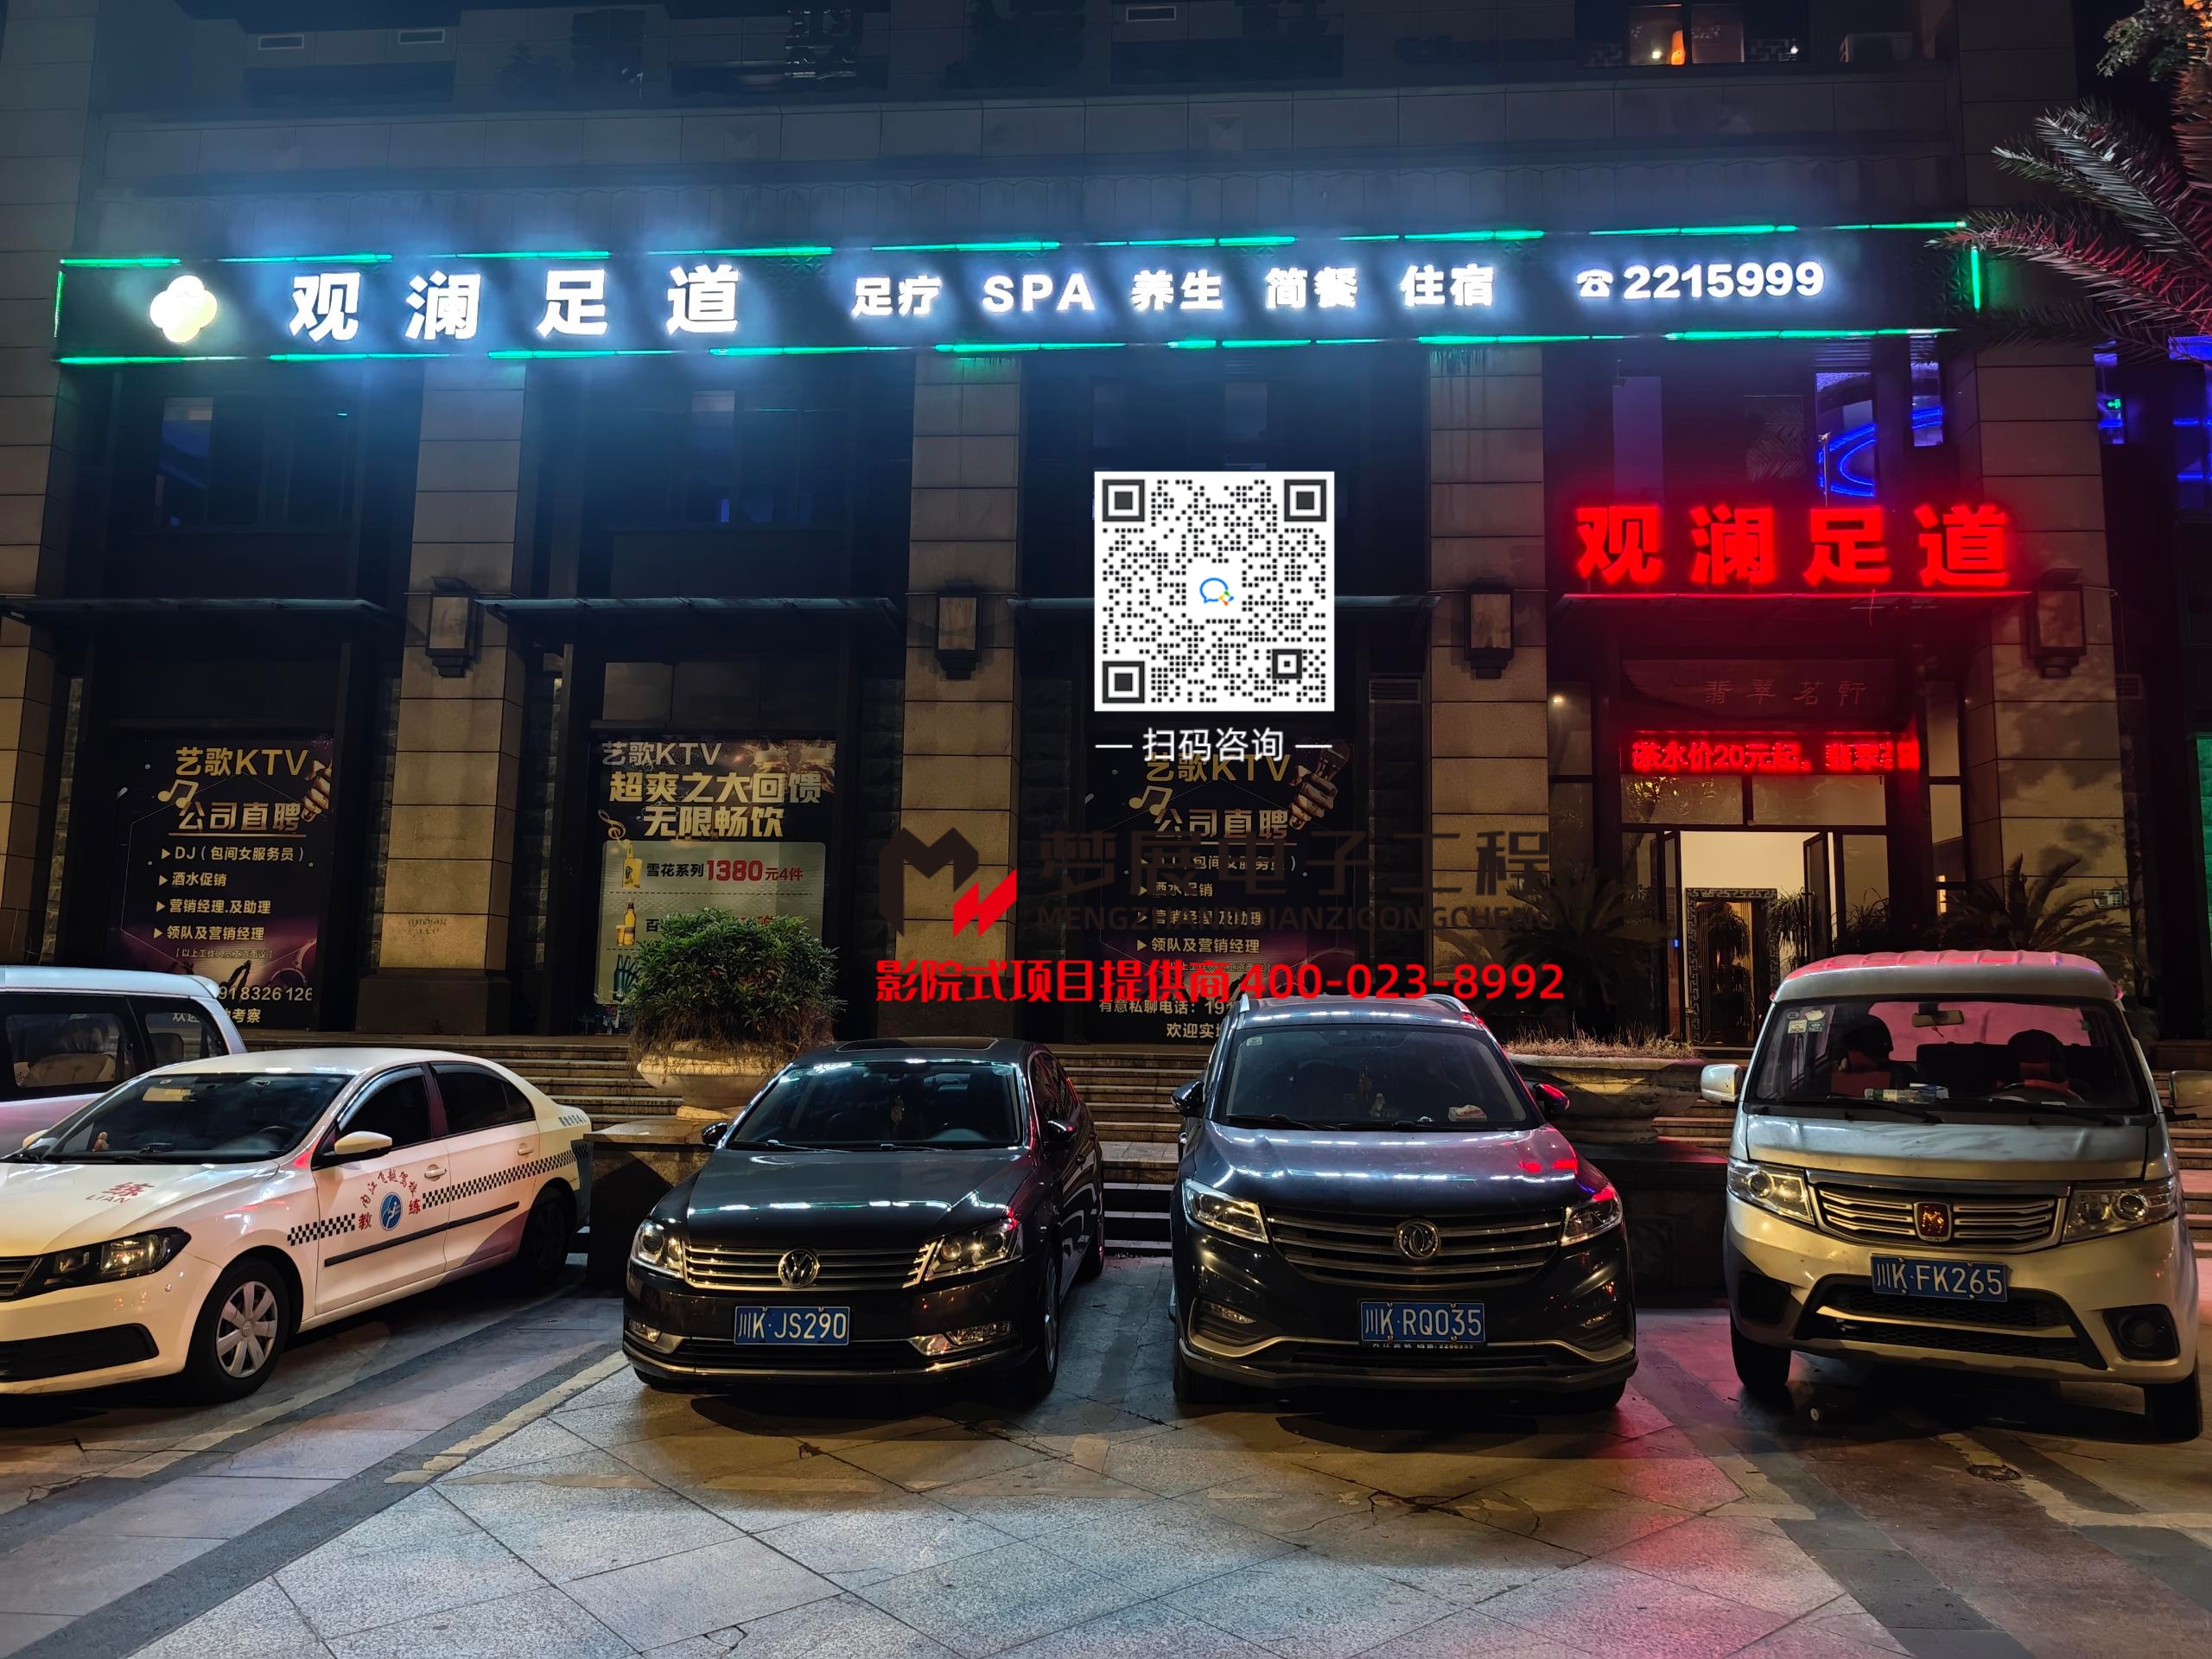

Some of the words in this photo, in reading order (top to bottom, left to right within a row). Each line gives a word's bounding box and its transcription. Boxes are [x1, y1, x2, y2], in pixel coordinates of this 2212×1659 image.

[289, 264, 740, 341] 观澜足道
[851, 275, 942, 318] 足疗
[982, 273, 1096, 313] SPA
[1131, 270, 1223, 311] 养生
[1265, 267, 1357, 308] 简餐
[1401, 264, 1493, 308] 住宿
[1623, 261, 1825, 300] 2215999
[1574, 503, 2012, 586] 观澜足道
[175, 747, 308, 777] 艺歌KTV
[602, 741, 721, 767] 艺歌KTV
[1145, 750, 1291, 782] 艺歌KTV
[609, 772, 822, 804] 超爽之大回馈
[178, 802, 302, 831] 公司直聘
[644, 805, 785, 838] 无限畅饮
[1154, 808, 1290, 841] 公司直聘
[171, 872, 227, 887] 酒水促销
[166, 926, 265, 942] 领队及营销经理
[1151, 937, 1261, 955] 领队及营销经理
[86, 1194, 131, 1204] LIAN
[409, 1198, 421, 1215] 练
[359, 1212, 372, 1230] 教
